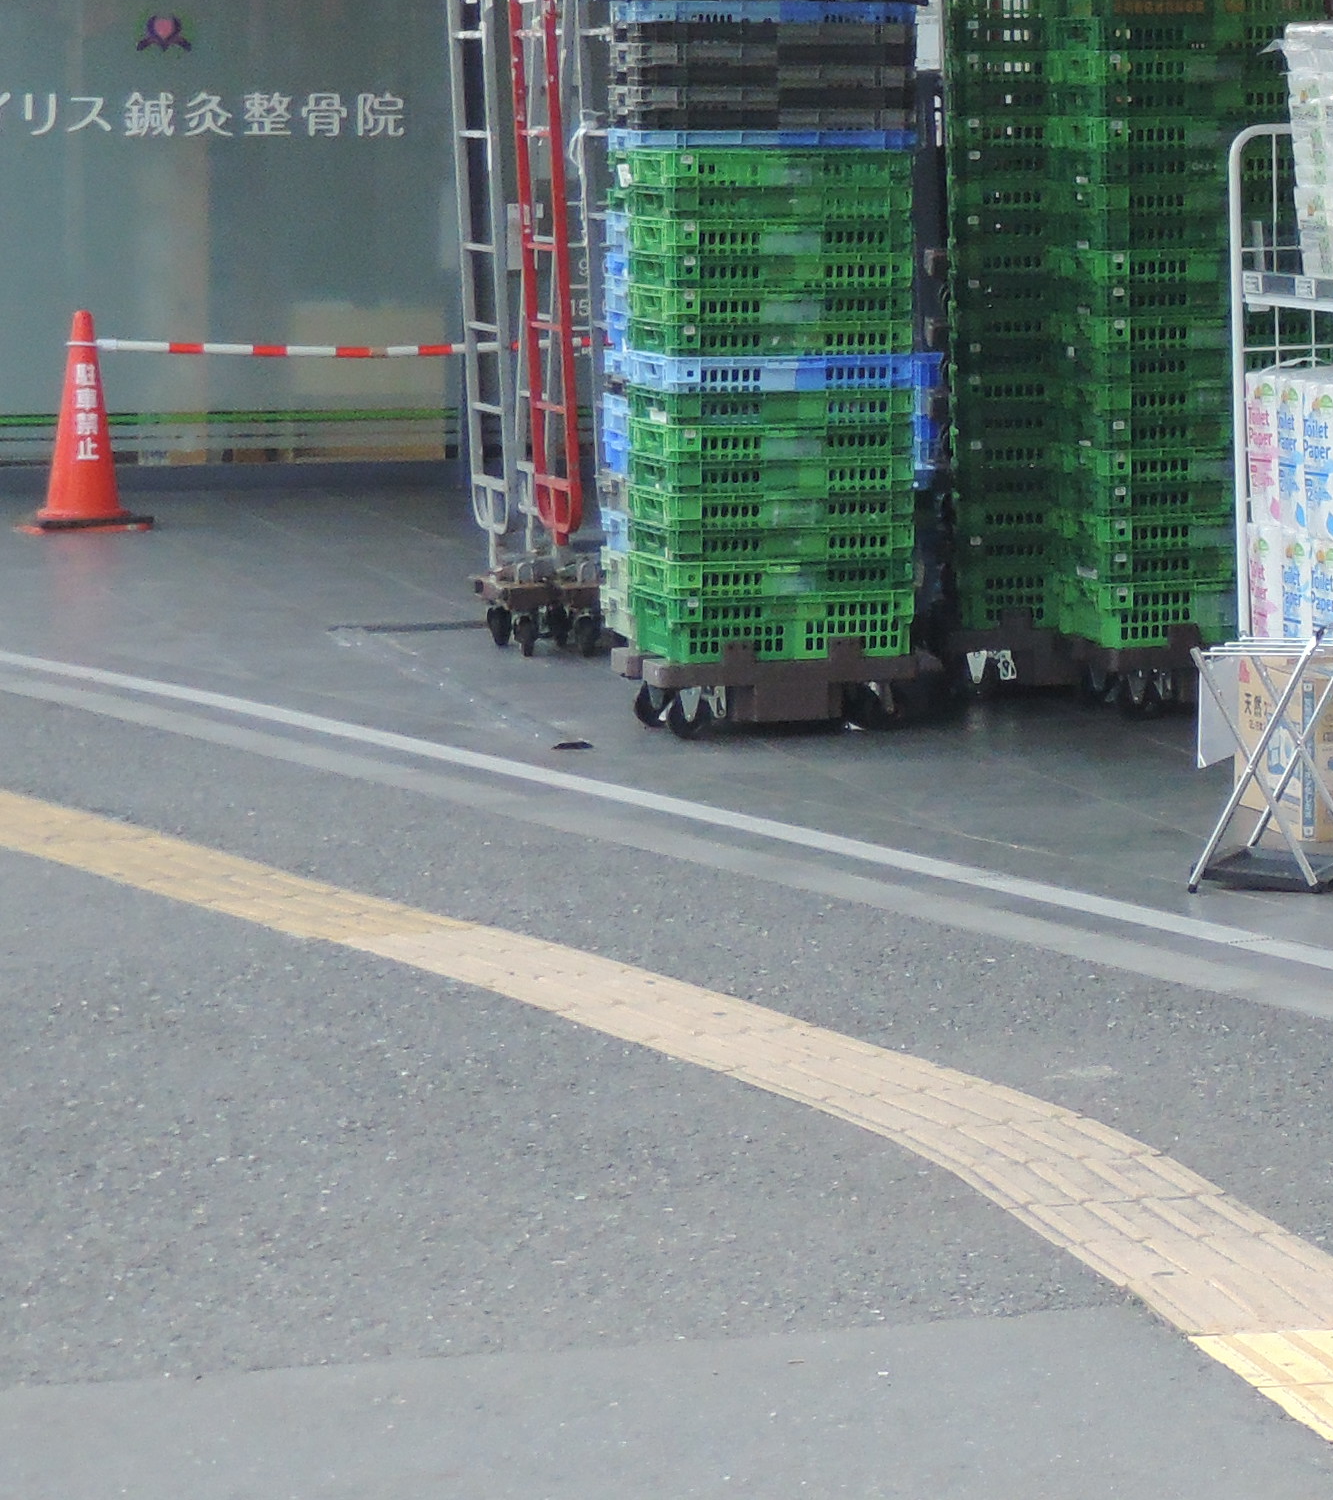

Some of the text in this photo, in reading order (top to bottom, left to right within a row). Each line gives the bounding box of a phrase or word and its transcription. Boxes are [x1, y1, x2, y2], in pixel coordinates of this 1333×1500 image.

[0, 92, 405, 138] リス鍼灸整骨院
[75, 362, 99, 462] 駐車禁止
[1303, 418, 1330, 440] Toilet
[1303, 442, 1332, 461] Paper
